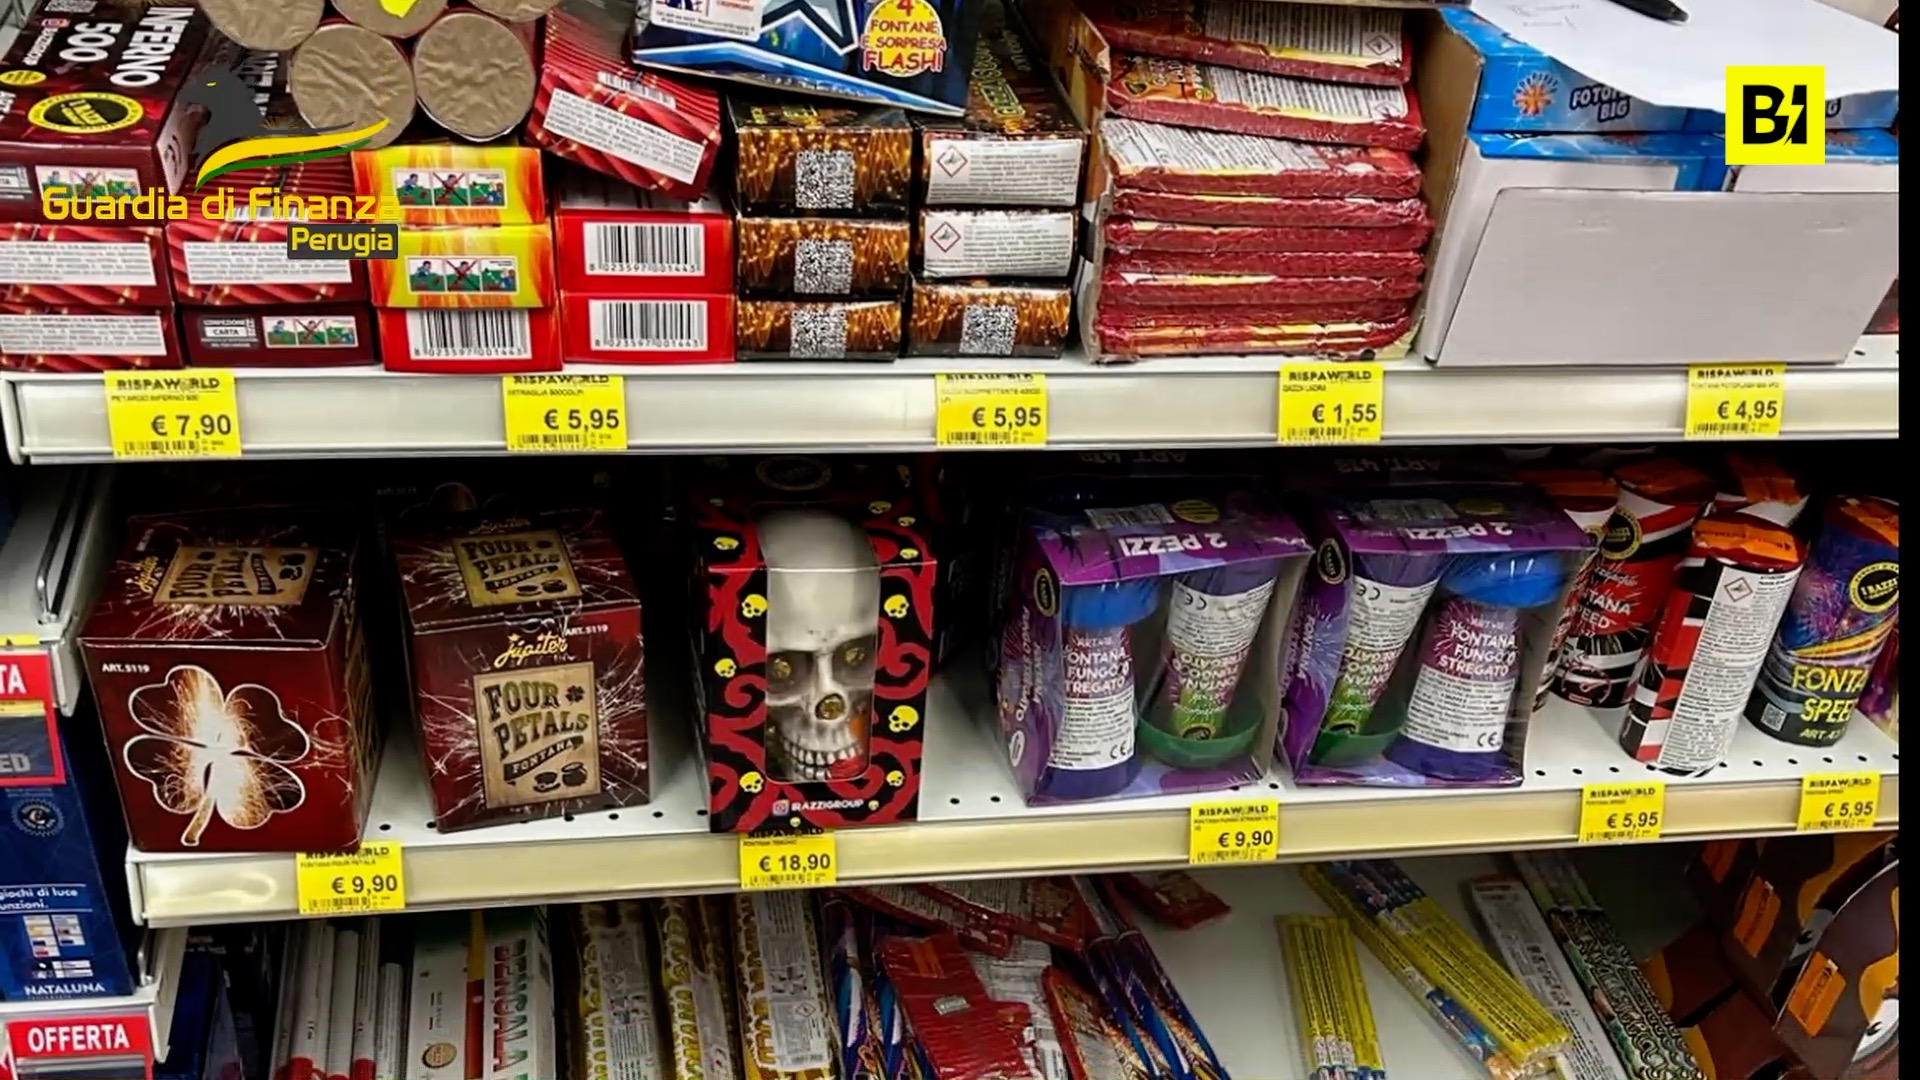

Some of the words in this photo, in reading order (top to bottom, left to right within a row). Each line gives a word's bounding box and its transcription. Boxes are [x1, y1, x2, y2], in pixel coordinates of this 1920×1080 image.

[897, 0, 914, 16] 4
[871, 19, 938, 33] FONTANE
[59, 22, 123, 62] 500
[110, 7, 195, 87] INFERNO
[862, 35, 870, 49] E
[876, 37, 946, 51] SORPRESA
[865, 50, 943, 71] FLASH!
[1600, 101, 1629, 121] BIG
[544, 409, 559, 430] €
[568, 408, 619, 432] 5,95
[972, 406, 986, 428] €
[994, 406, 1042, 430] 5,95
[1312, 403, 1325, 423] €
[1333, 403, 1377, 426] 1,55
[1718, 401, 1730, 419] €
[1735, 400, 1778, 421] 4,95
[151, 415, 168, 436] €
[175, 414, 232, 439] 7,90
[1404, 524, 1488, 540] PEZZI
[1489, 522, 1513, 536] 2
[1118, 533, 1203, 557] PEZZI
[1204, 532, 1228, 548] 2
[1451, 629, 1517, 650] FONTANA
[1454, 643, 1503, 663] FUNGO
[1439, 655, 1509, 677] STREGATO
[483, 680, 561, 723] FOUR
[494, 711, 590, 761] PETALS
[512, 738, 574, 774] FONTANA
[1607, 812, 1618, 829] €
[1622, 811, 1659, 829] 5,95
[1825, 802, 1836, 818] €
[1839, 801, 1874, 818] 5,95
[1218, 832, 1230, 848] €
[1235, 830, 1274, 848] 9,90
[759, 856, 772, 872] €
[778, 853, 831, 872] 18,90
[37, 887, 50, 897] di
[52, 887, 79, 897] luce
[332, 876, 345, 894] €
[352, 874, 398, 896] 9,90
[23, 982, 106, 996] NATALUNA
[27, 1023, 131, 1053] OFFERTA
